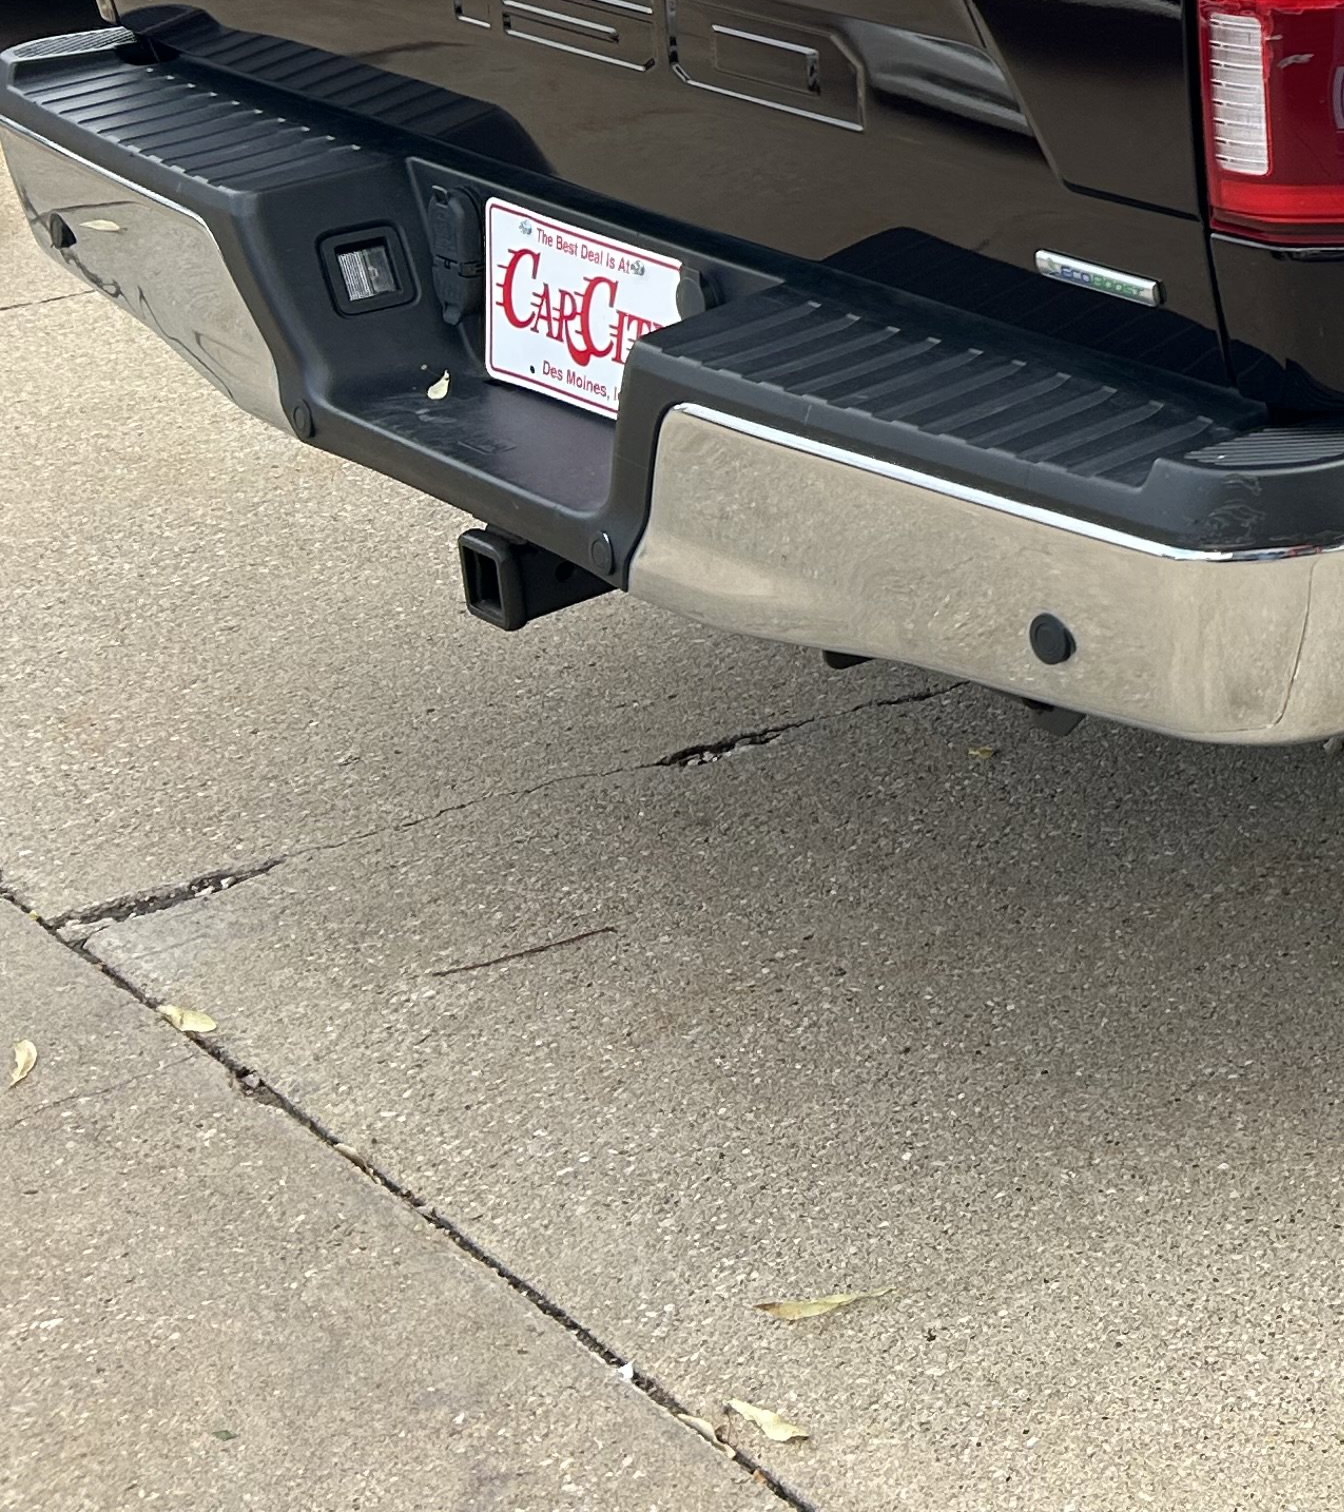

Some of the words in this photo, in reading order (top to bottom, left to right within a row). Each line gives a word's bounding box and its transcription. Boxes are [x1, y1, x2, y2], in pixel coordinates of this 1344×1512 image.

[537, 228, 553, 247] The
[557, 235, 578, 257] Best
[581, 245, 603, 266] Deal
[543, 360, 563, 382] Des
